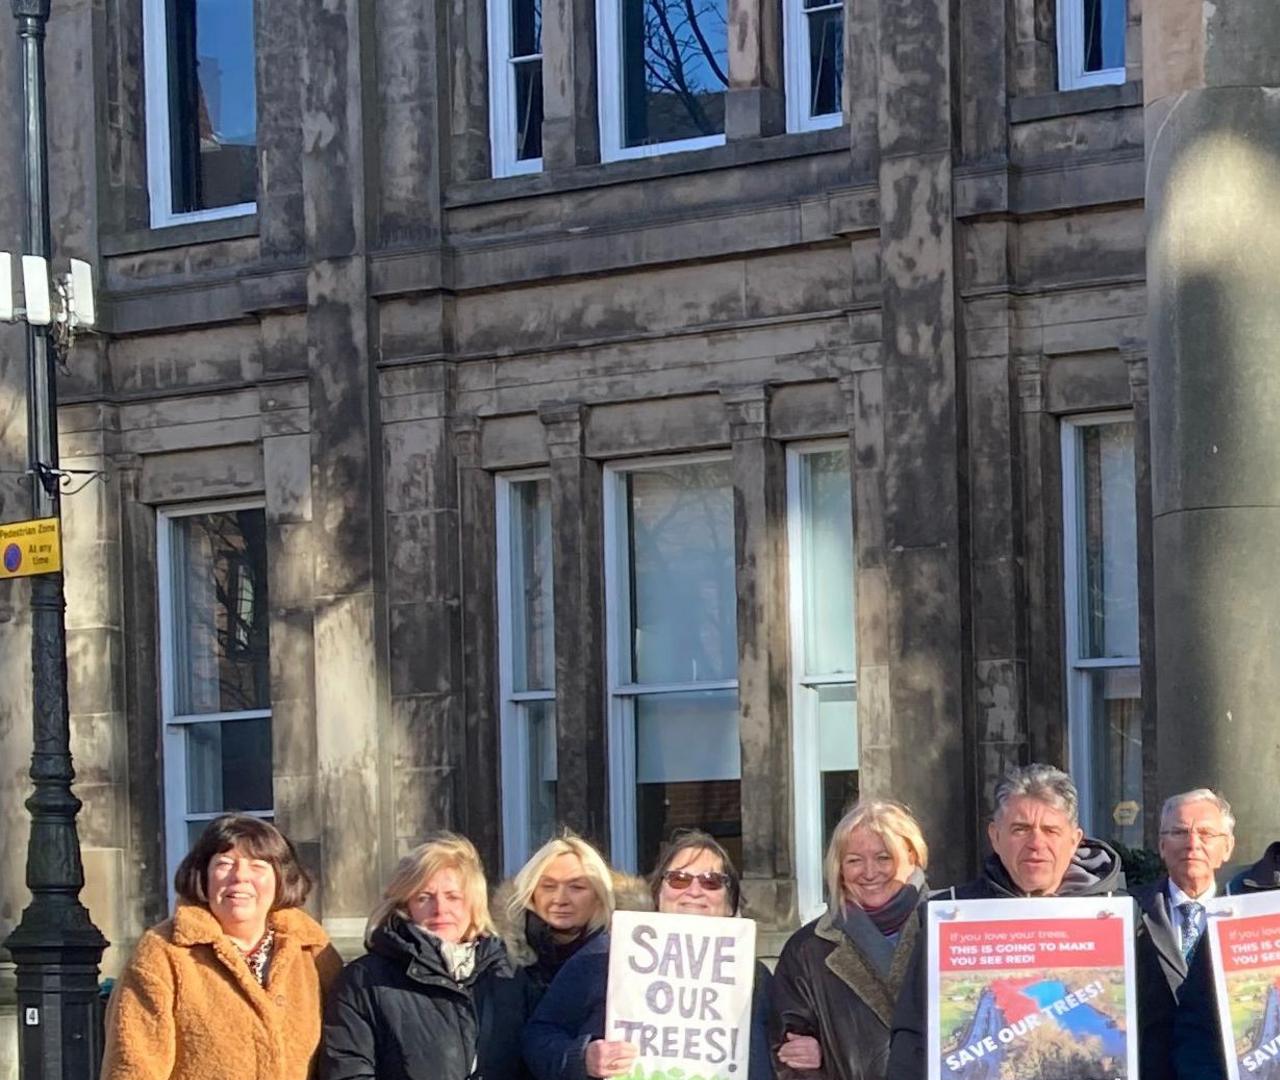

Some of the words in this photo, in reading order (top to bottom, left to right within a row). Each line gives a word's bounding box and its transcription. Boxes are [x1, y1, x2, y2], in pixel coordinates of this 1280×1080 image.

[951, 932, 957, 941] If
[959, 934, 981, 943] you
[985, 932, 1007, 940] love
[1010, 932, 1035, 941] your
[950, 946, 978, 954] THIS
[981, 945, 993, 954] IS
[997, 943, 1035, 953] GOING
[1039, 943, 1056, 952] TO
[1060, 941, 1095, 951] MAKE
[1231, 942, 1259, 953] THIS
[1261, 941, 1272, 950] IS
[628, 924, 736, 985] SAVE
[950, 957, 976, 966] YOU
[979, 956, 1003, 964] SEE
[1006, 954, 1035, 964] RED!
[1232, 955, 1258, 965] YOU
[645, 980, 722, 1020] OUR
[945, 1036, 998, 1071] SAVE
[998, 1013, 1042, 1043] OUR
[1041, 980, 1104, 1020] TREES!
[614, 1020, 739, 1073] TREES!
